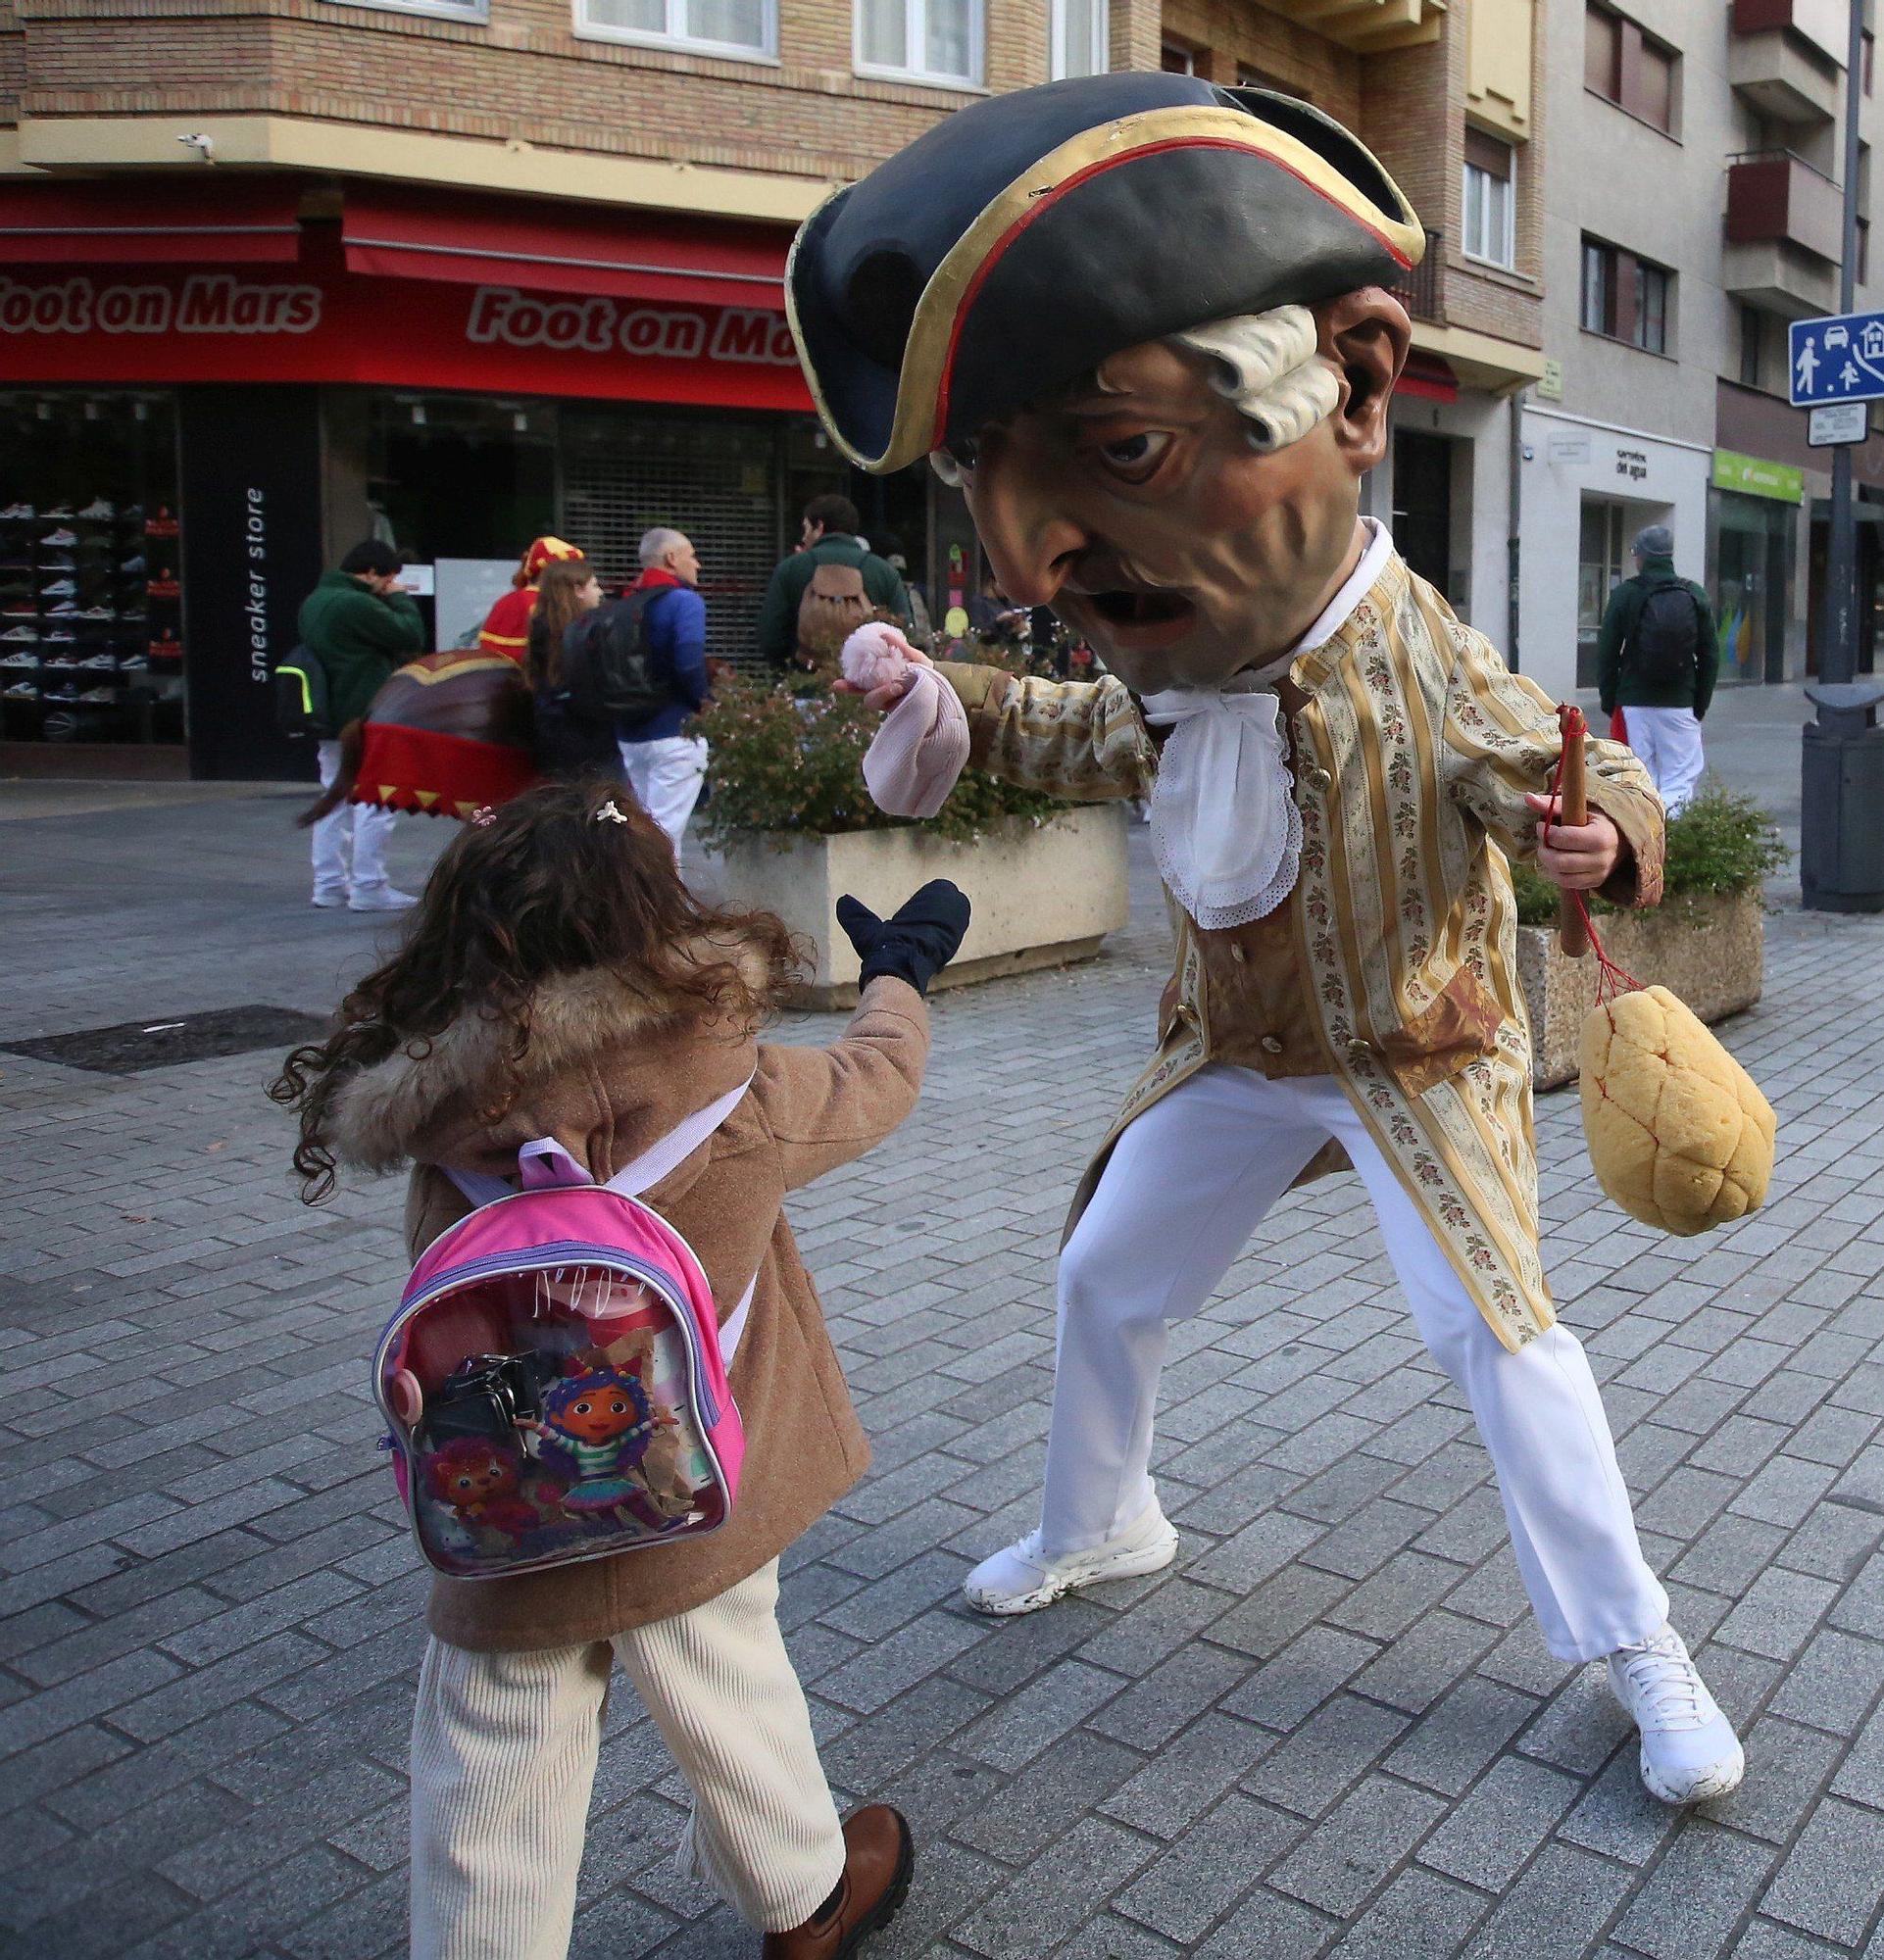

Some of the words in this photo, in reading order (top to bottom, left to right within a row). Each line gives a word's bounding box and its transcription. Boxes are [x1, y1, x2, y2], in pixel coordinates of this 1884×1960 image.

[98, 284, 173, 333] on
[175, 274, 322, 333] Mars
[467, 286, 618, 352] Foot
[620, 309, 707, 359] on
[710, 307, 802, 366] Ma
[246, 488, 266, 560] store
[245, 569, 268, 683] sneaker
